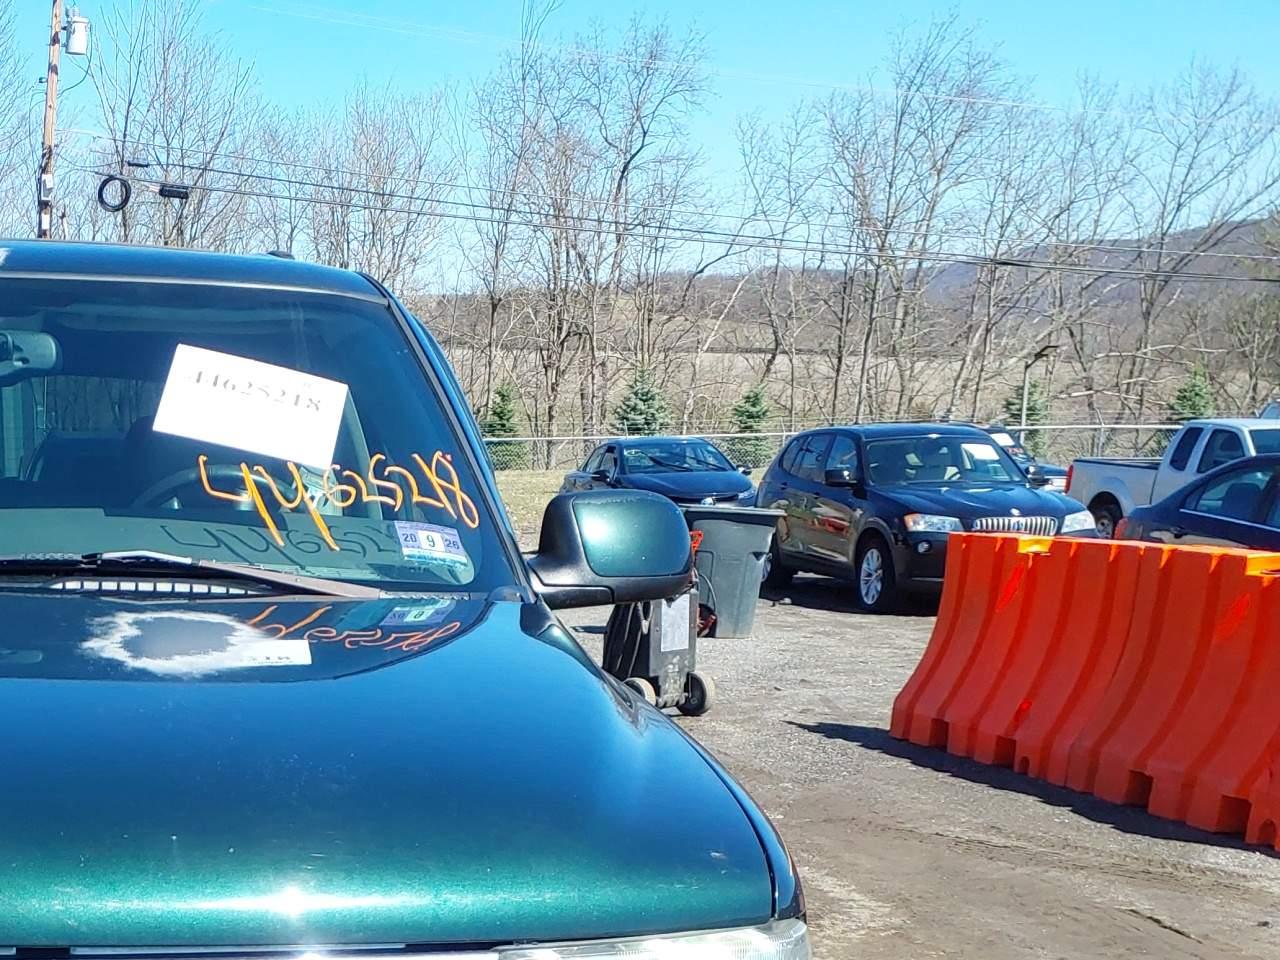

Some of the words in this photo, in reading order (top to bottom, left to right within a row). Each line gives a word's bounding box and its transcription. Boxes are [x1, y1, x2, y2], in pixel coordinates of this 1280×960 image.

[198, 450, 479, 551] 44625218
[401, 532, 418, 543] 20
[426, 534, 436, 548] 9
